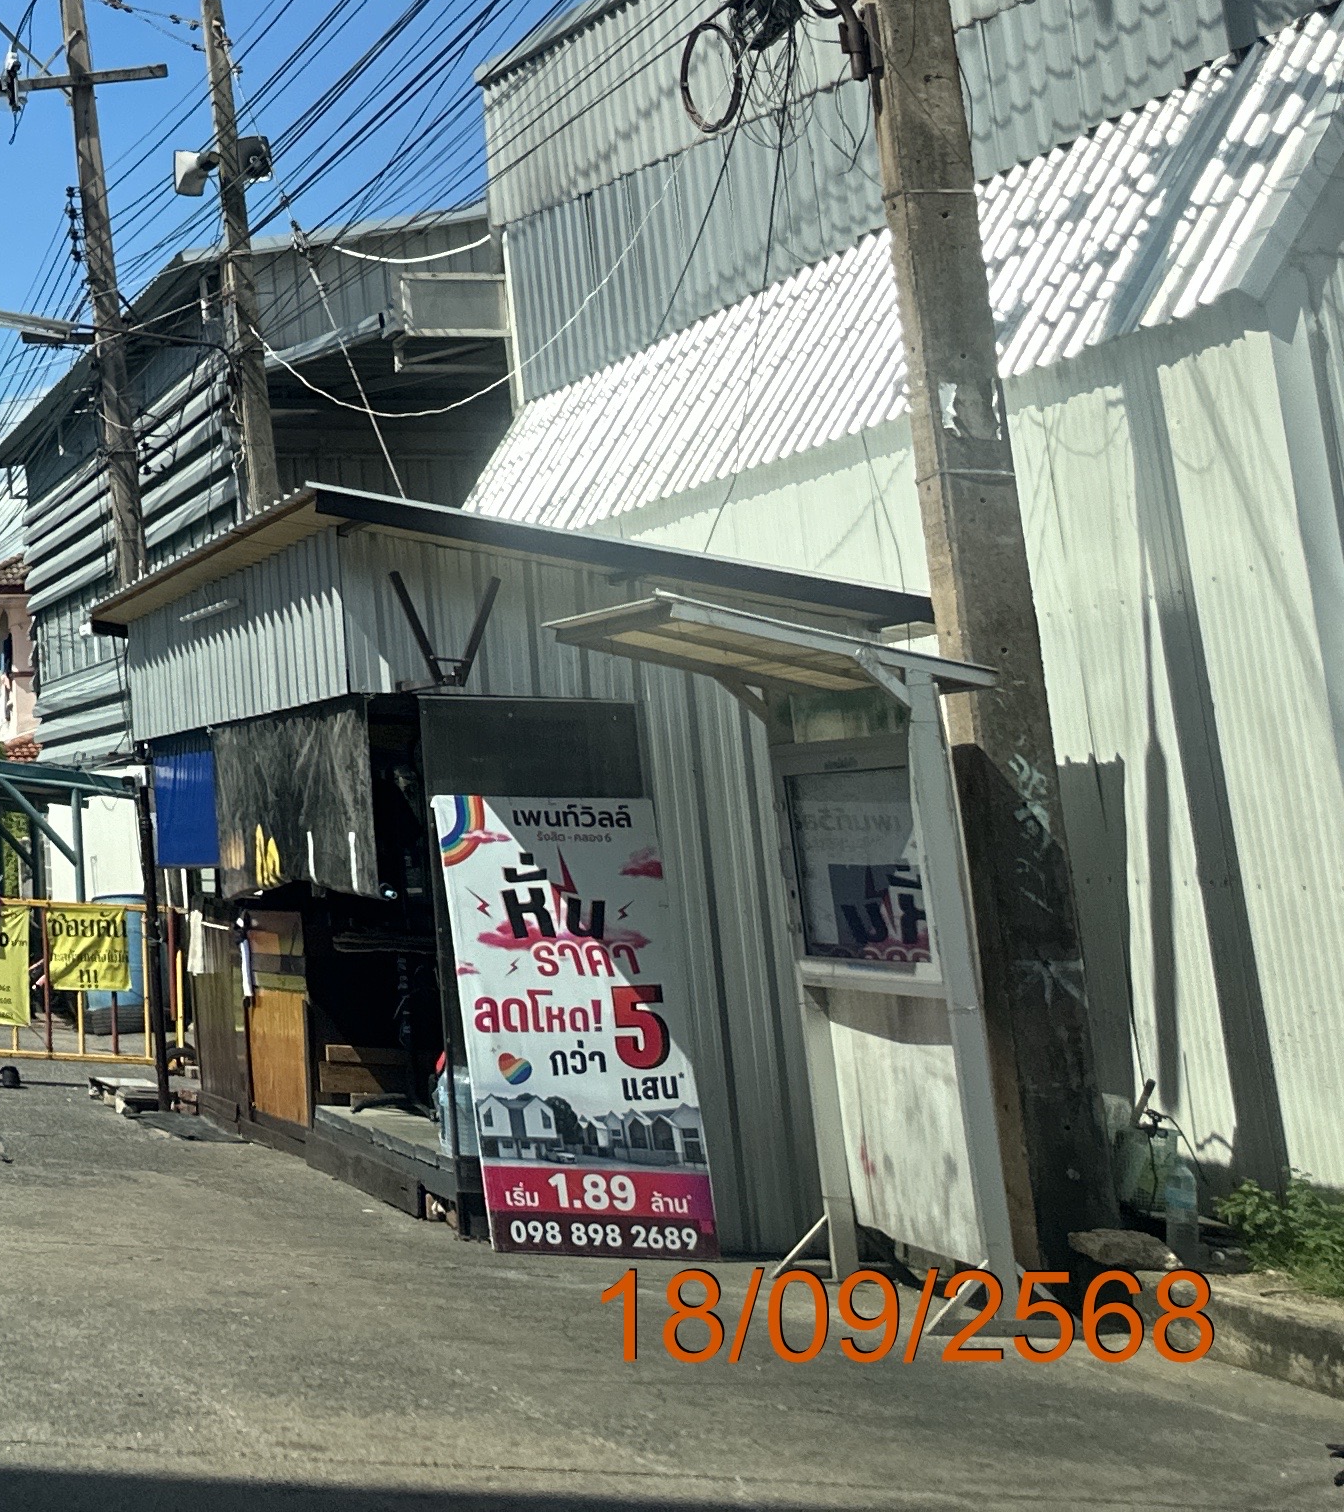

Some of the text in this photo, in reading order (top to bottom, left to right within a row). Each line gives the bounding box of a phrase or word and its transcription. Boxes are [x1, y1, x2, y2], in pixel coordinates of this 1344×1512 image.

[512, 804, 632, 828] เพนท์วิลล์
[501, 852, 605, 940] หั่น
[532, 943, 640, 977] ราคา
[474, 990, 602, 1033] ลดโหด!
[611, 984, 671, 1070] 5
[549, 1039, 607, 1076] กว่า
[505, 1181, 539, 1207] เริ่ม
[548, 1173, 637, 1211] 1.89
[510, 1220, 698, 1250] 098 898 2689
